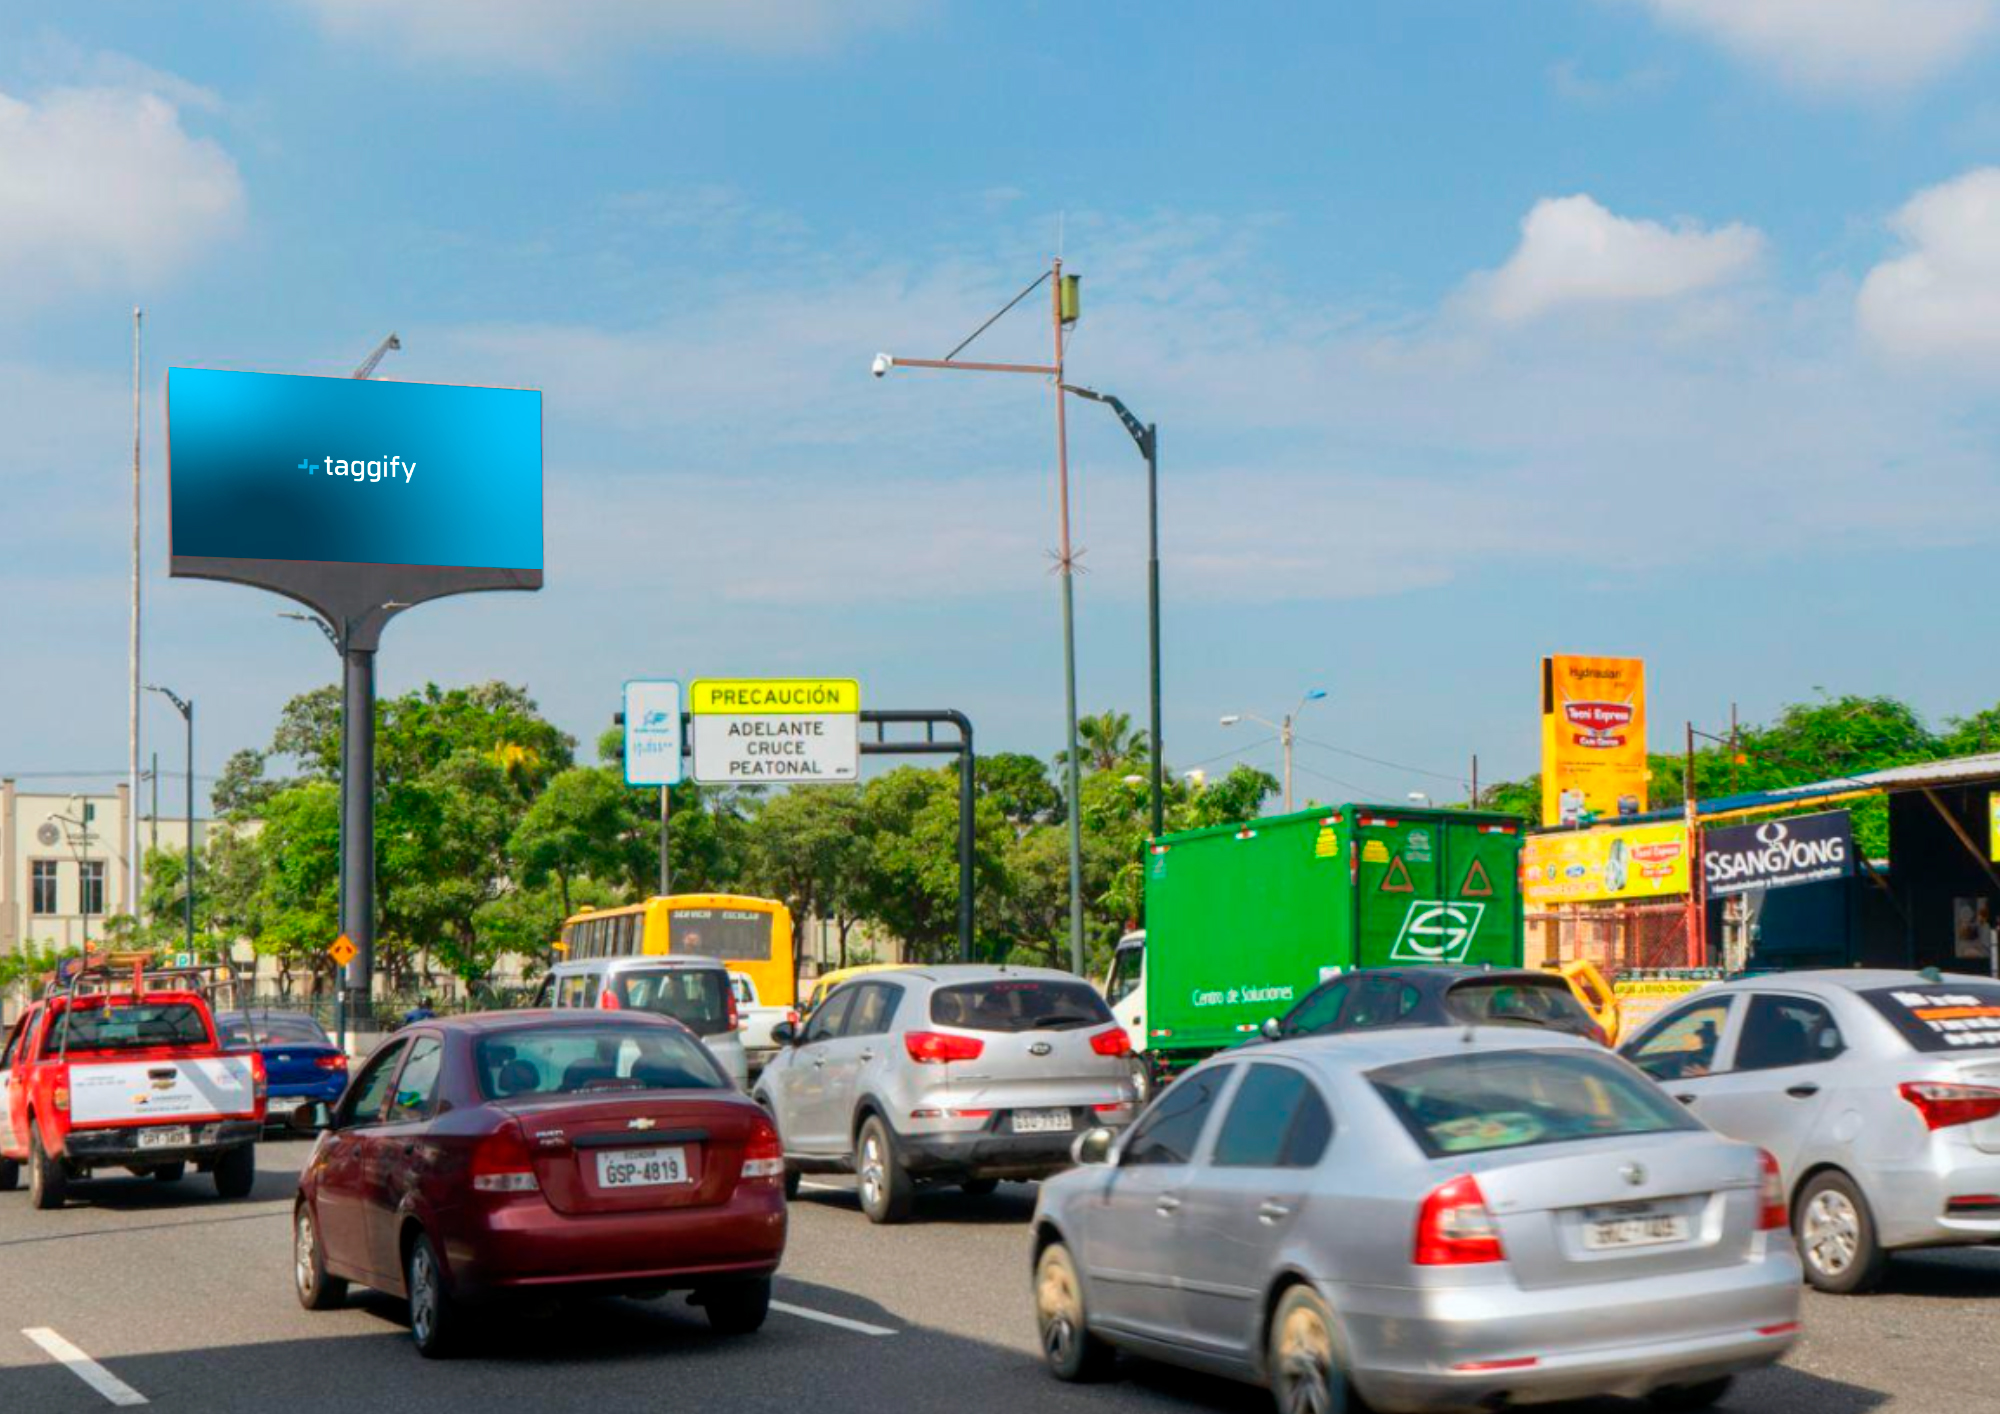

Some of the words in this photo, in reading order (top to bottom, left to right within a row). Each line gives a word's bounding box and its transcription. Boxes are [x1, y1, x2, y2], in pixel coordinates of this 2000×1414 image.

[323, 454, 417, 484] taggify
[711, 684, 840, 705] PRECAUCIÓN
[728, 721, 824, 736] ADELANTE
[747, 741, 805, 755] CRUCE
[729, 760, 822, 775] PEATONAL
[1192, 989, 1224, 1006] Centro
[1226, 987, 1239, 1004] de
[1241, 984, 1294, 1003] Soluciones
[606, 1160, 678, 1184] GSP-4819
